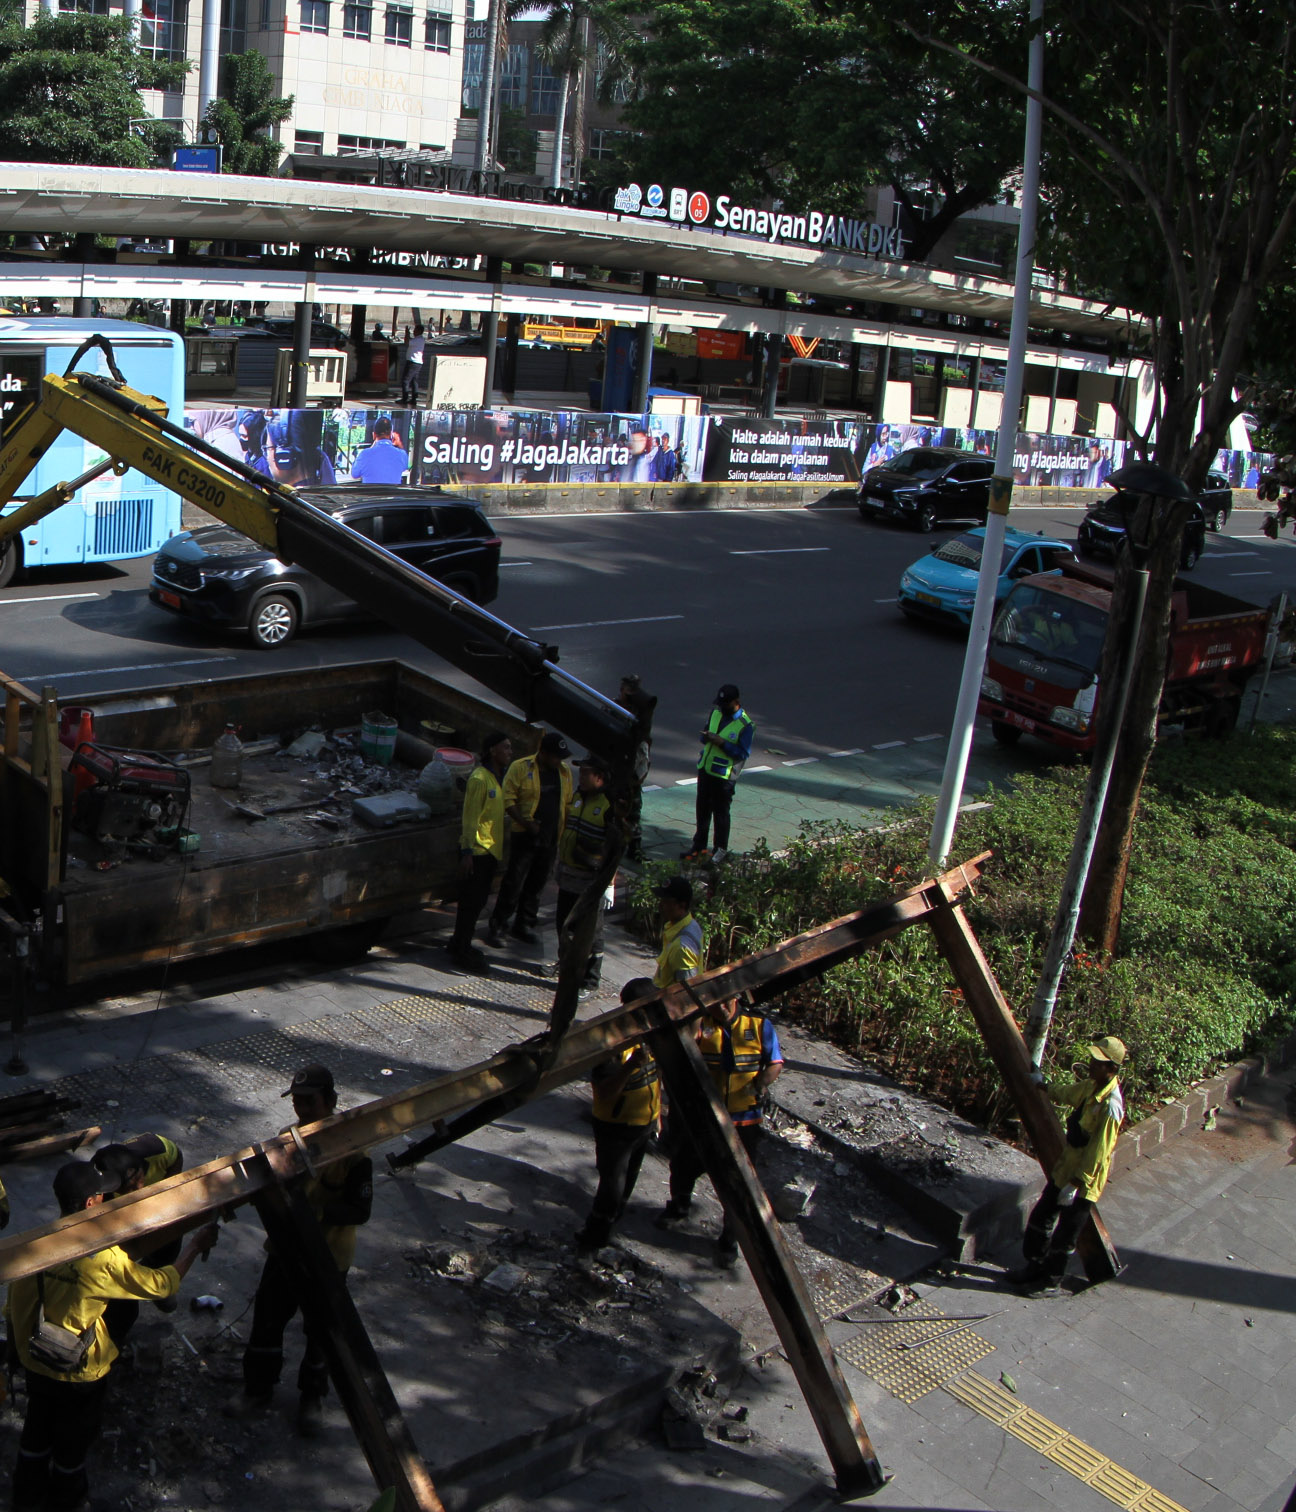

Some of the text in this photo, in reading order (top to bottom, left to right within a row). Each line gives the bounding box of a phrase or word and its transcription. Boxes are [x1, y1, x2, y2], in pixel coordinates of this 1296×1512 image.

[345, 69, 407, 92] GRAHA
[322, 86, 424, 115] CIMB NIAGA
[615, 201, 639, 213] Lingko
[697, 198, 702, 206] 1
[694, 209, 703, 218] 05
[715, 195, 904, 259] Senayan BANK DKI
[731, 429, 849, 448] Halte adalah rumah kedua
[422, 435, 630, 473] Saling #JagaJakarta
[729, 448, 829, 468] kita dalam perjalanan
[1030, 450, 1090, 474] #JagaJakarta
[727, 469, 748, 482] Saling
[749, 471, 786, 482] #JagaJakarta
[177, 468, 227, 508] C3200
[1018, 659, 1048, 674] ISUZU
